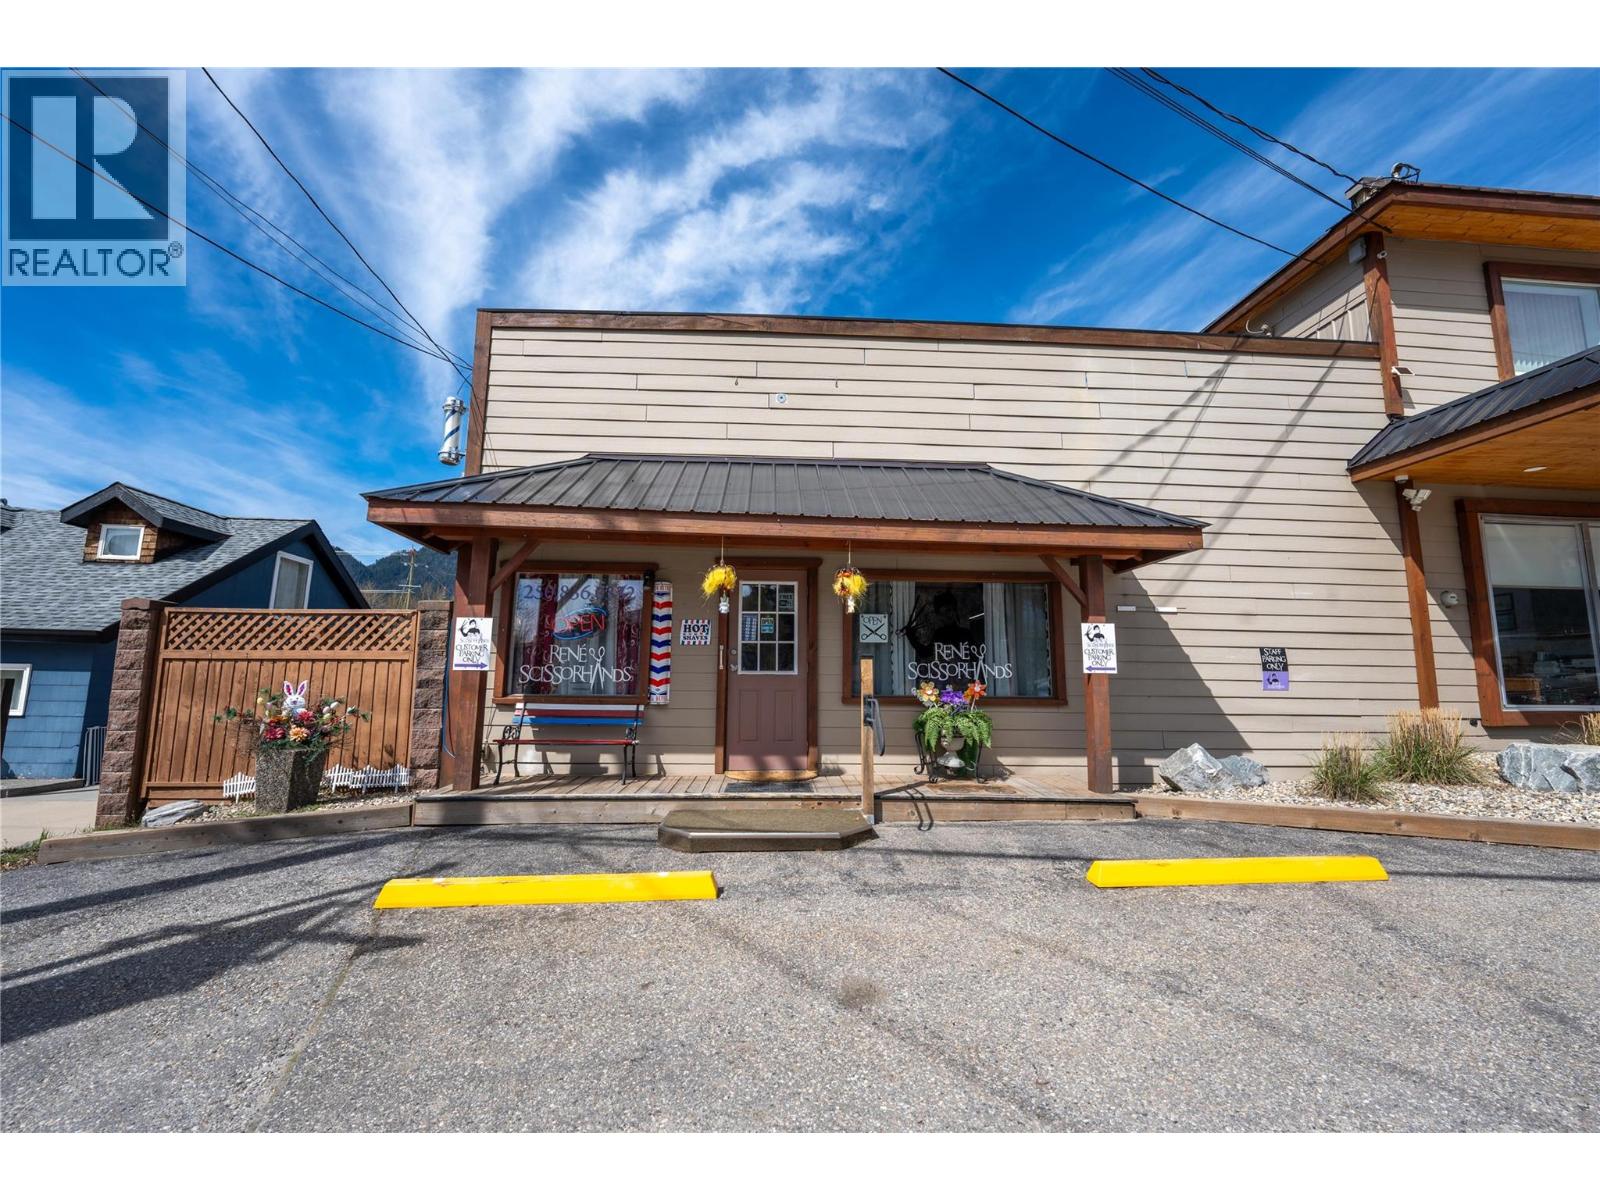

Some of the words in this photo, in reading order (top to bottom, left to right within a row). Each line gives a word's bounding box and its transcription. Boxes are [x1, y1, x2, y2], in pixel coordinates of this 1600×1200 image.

[553, 613, 606, 633] OPEN
[683, 624, 708, 633] HOT
[456, 644, 489, 652] CUSTOMER
[1263, 648, 1281, 656] STAFF
[463, 656, 481, 664] ONLY
[519, 664, 633, 689] SCISSORHANDS
[908, 661, 1013, 683] SCISSORHANDS
